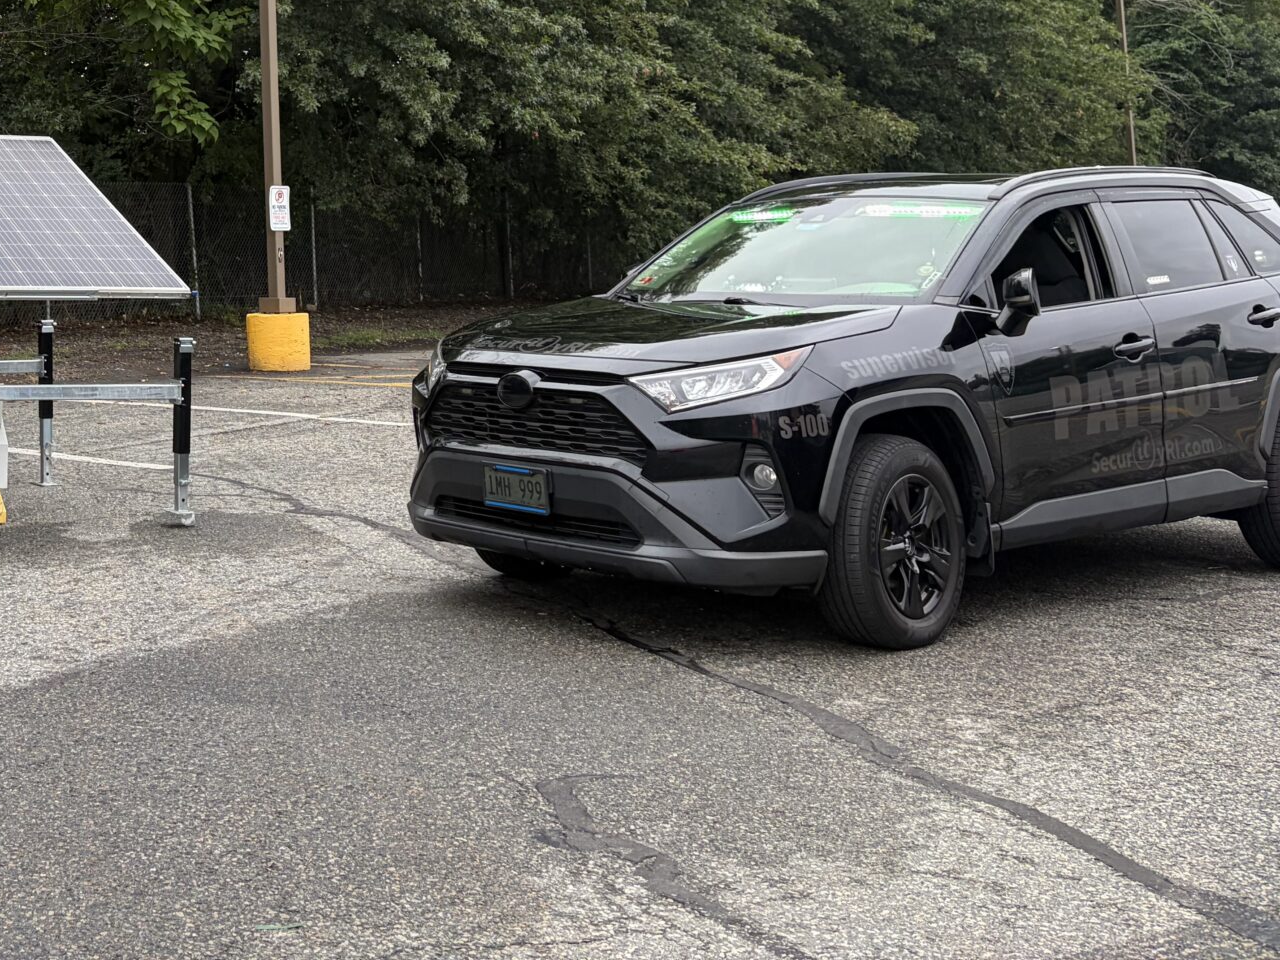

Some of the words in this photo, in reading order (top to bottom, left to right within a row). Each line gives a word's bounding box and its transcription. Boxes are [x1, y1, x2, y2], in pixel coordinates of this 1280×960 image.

[1049, 353, 1240, 440] PATROL
[778, 413, 830, 440] S-100
[488, 475, 511, 497] 1MH
[519, 478, 542, 500] 999
